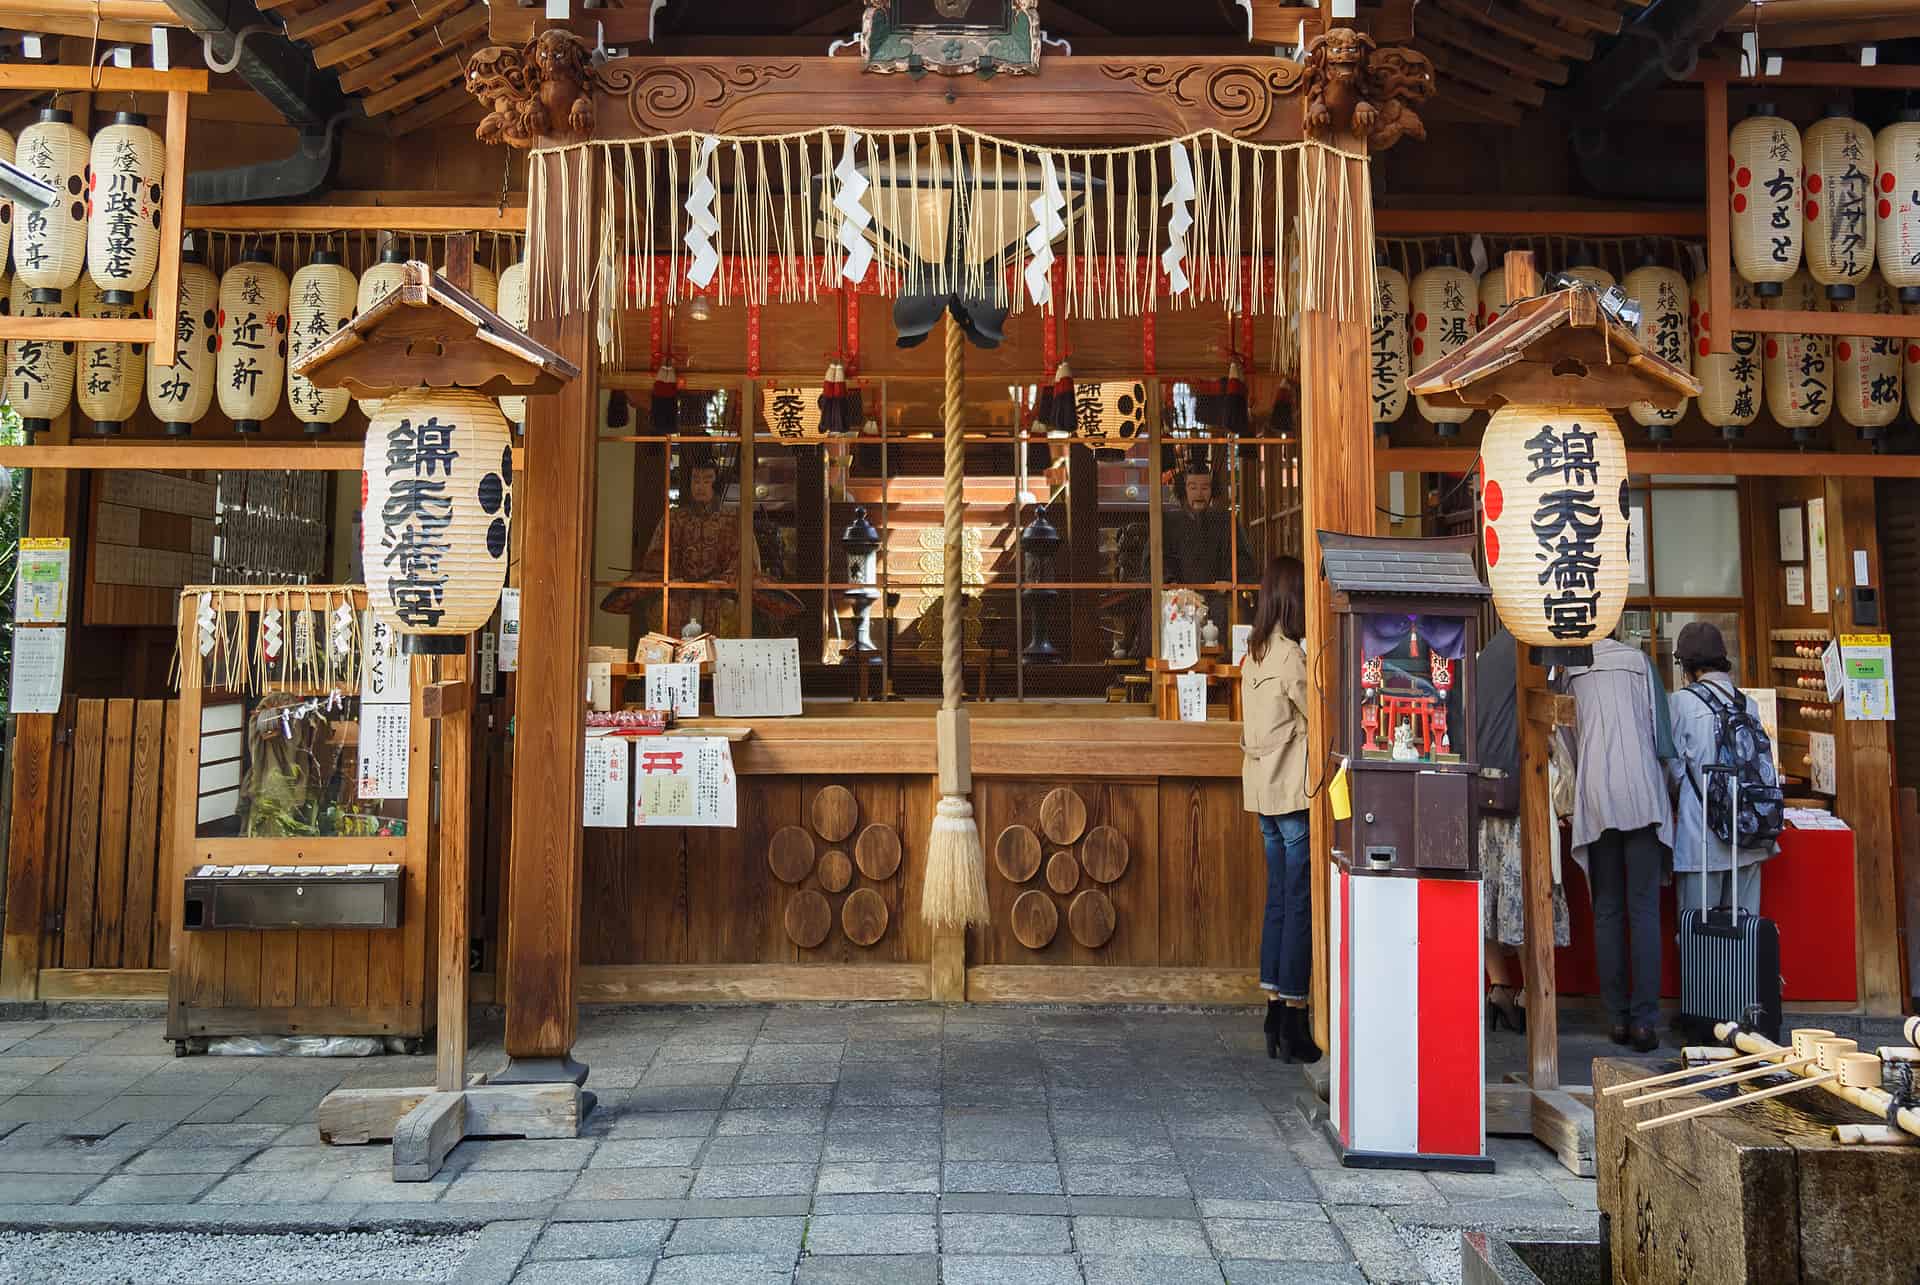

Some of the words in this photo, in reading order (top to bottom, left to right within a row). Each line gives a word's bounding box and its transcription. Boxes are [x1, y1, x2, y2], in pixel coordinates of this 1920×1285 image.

[232, 312, 266, 397] 近新
[382, 417, 459, 626] 錦天満宮
[1524, 423, 1604, 640] 錦天満宮
[372, 622, 387, 695] おみくじ
